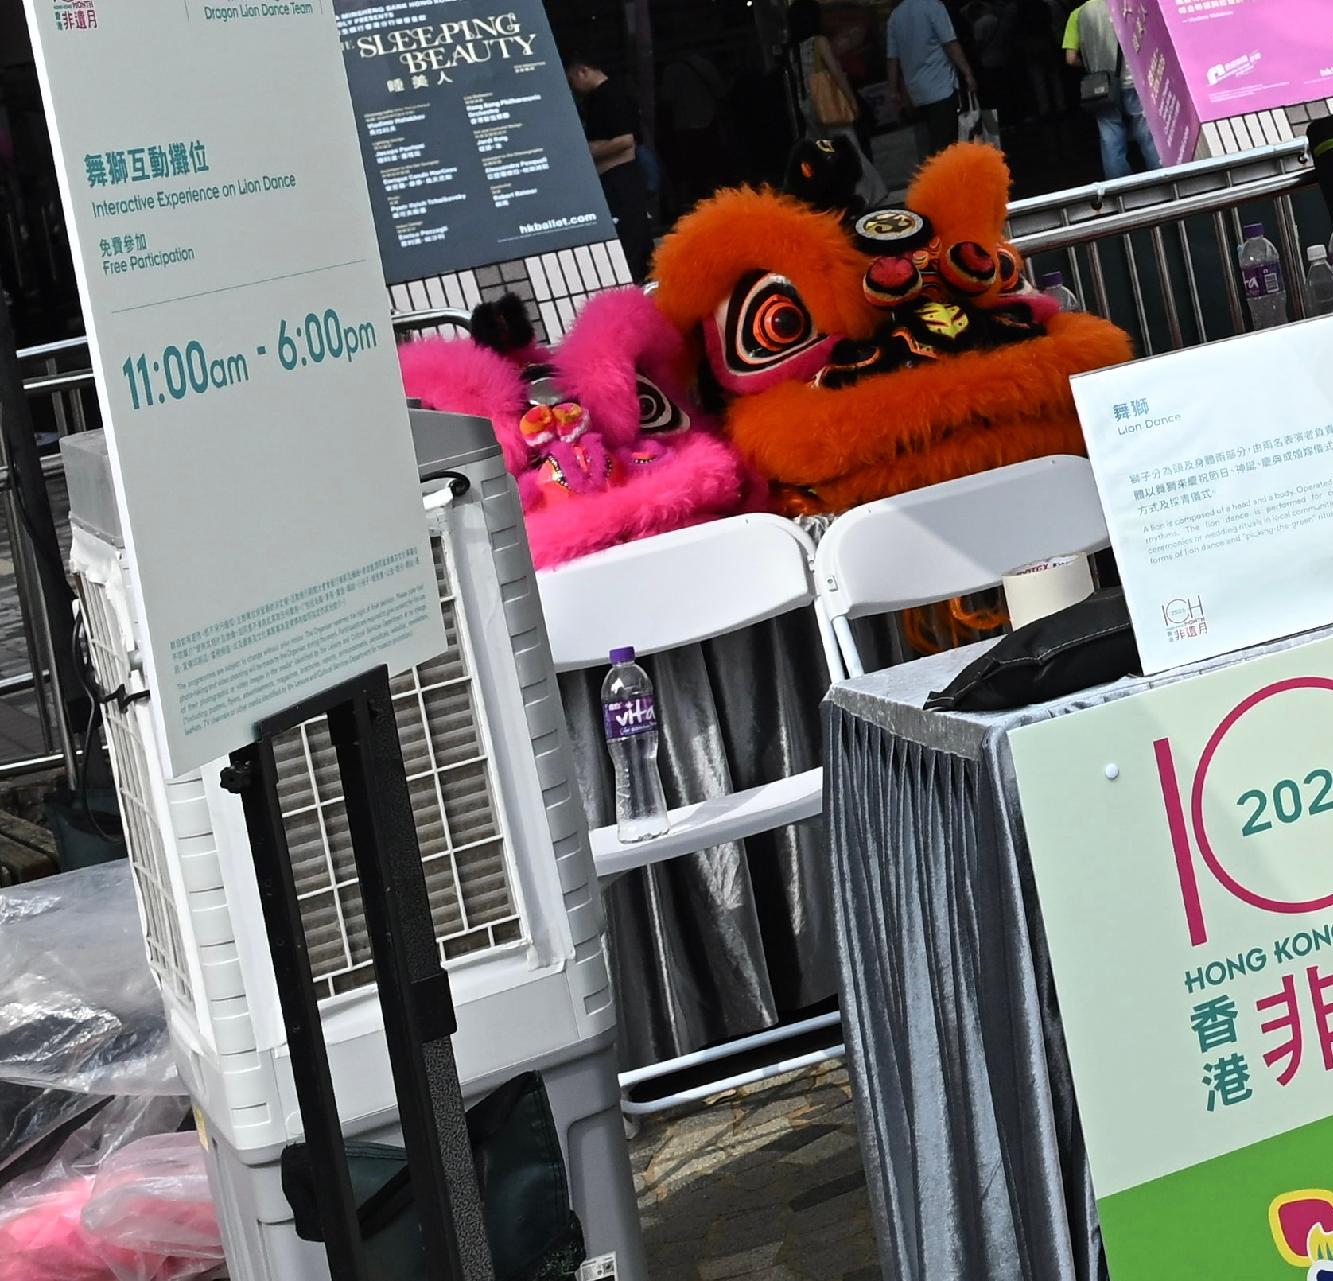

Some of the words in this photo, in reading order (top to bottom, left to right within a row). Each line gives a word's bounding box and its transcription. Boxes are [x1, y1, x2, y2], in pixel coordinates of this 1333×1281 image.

[204, 5, 240, 23] Dragon
[241, 4, 260, 18] Lion
[261, 2, 289, 17] Dance
[289, 1, 313, 16] Team
[357, 12, 520, 59] SLEEPING
[399, 33, 536, 74] BEAUTY
[84, 140, 209, 188] 舞獅互動攤位
[92, 194, 155, 218] Interactive
[157, 185, 220, 209] Experience
[222, 184, 236, 197] on
[237, 178, 262, 195] Lion
[263, 173, 296, 191] Dance
[99, 233, 147, 257] 免費參加
[103, 259, 127, 275] Free
[130, 247, 195, 271] Participation
[122, 340, 249, 410] 11:00am
[256, 345, 267, 355] -
[277, 308, 377, 371] 6:00pm
[1113, 397, 1151, 421] 舞獅
[1117, 422, 1143, 437] Lion
[1145, 413, 1182, 429] Dance
[1185, 523, 1200, 532] The
[1224, 510, 1249, 523] dance
[1161, 595, 1204, 626] ICH
[615, 698, 656, 727] vita
[1184, 945, 1269, 993] HONG
[1190, 994, 1253, 1113] 香港
